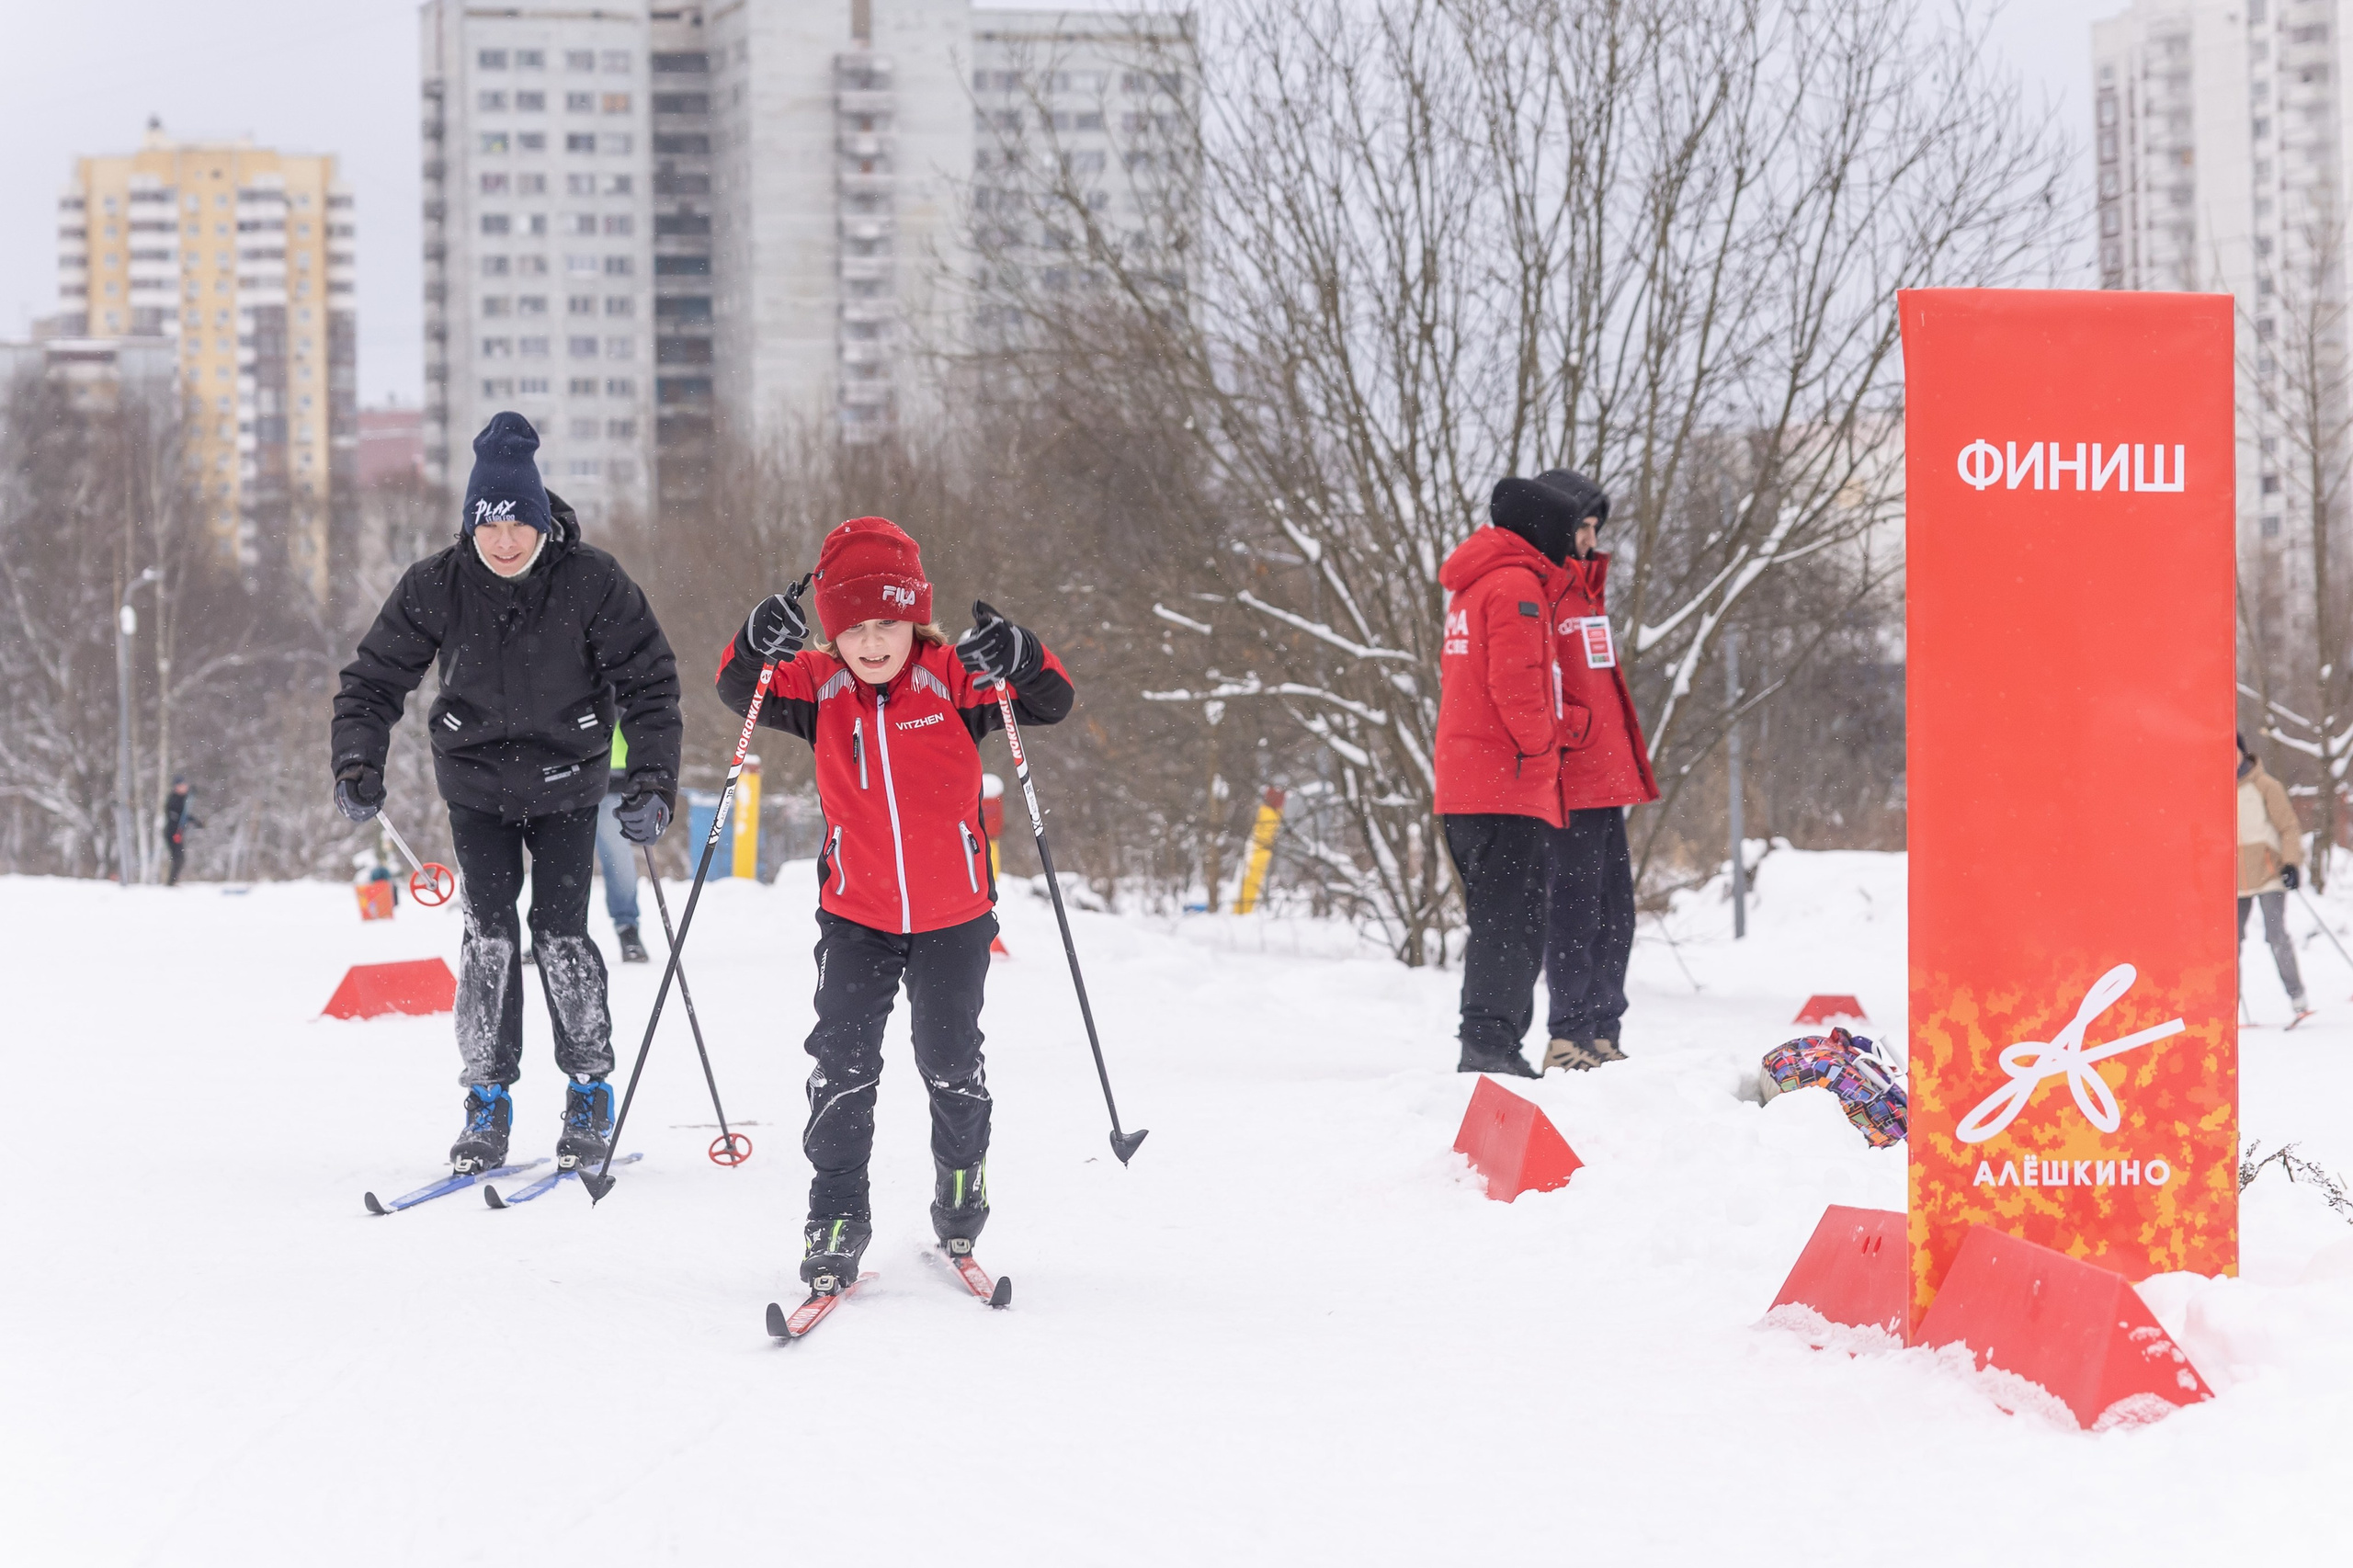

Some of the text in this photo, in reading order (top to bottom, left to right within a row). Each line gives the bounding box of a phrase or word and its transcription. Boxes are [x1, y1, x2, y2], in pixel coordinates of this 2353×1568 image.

[1957, 438, 2185, 492] ФИНИШ
[474, 498, 517, 525] PLAY
[882, 585, 915, 606] FILA
[735, 688, 764, 759] NORDWAY
[895, 712, 944, 731] VITZHEN
[998, 698, 1023, 759] NORDWAY
[1972, 1154, 2171, 1187] АЛЁШКИНО
